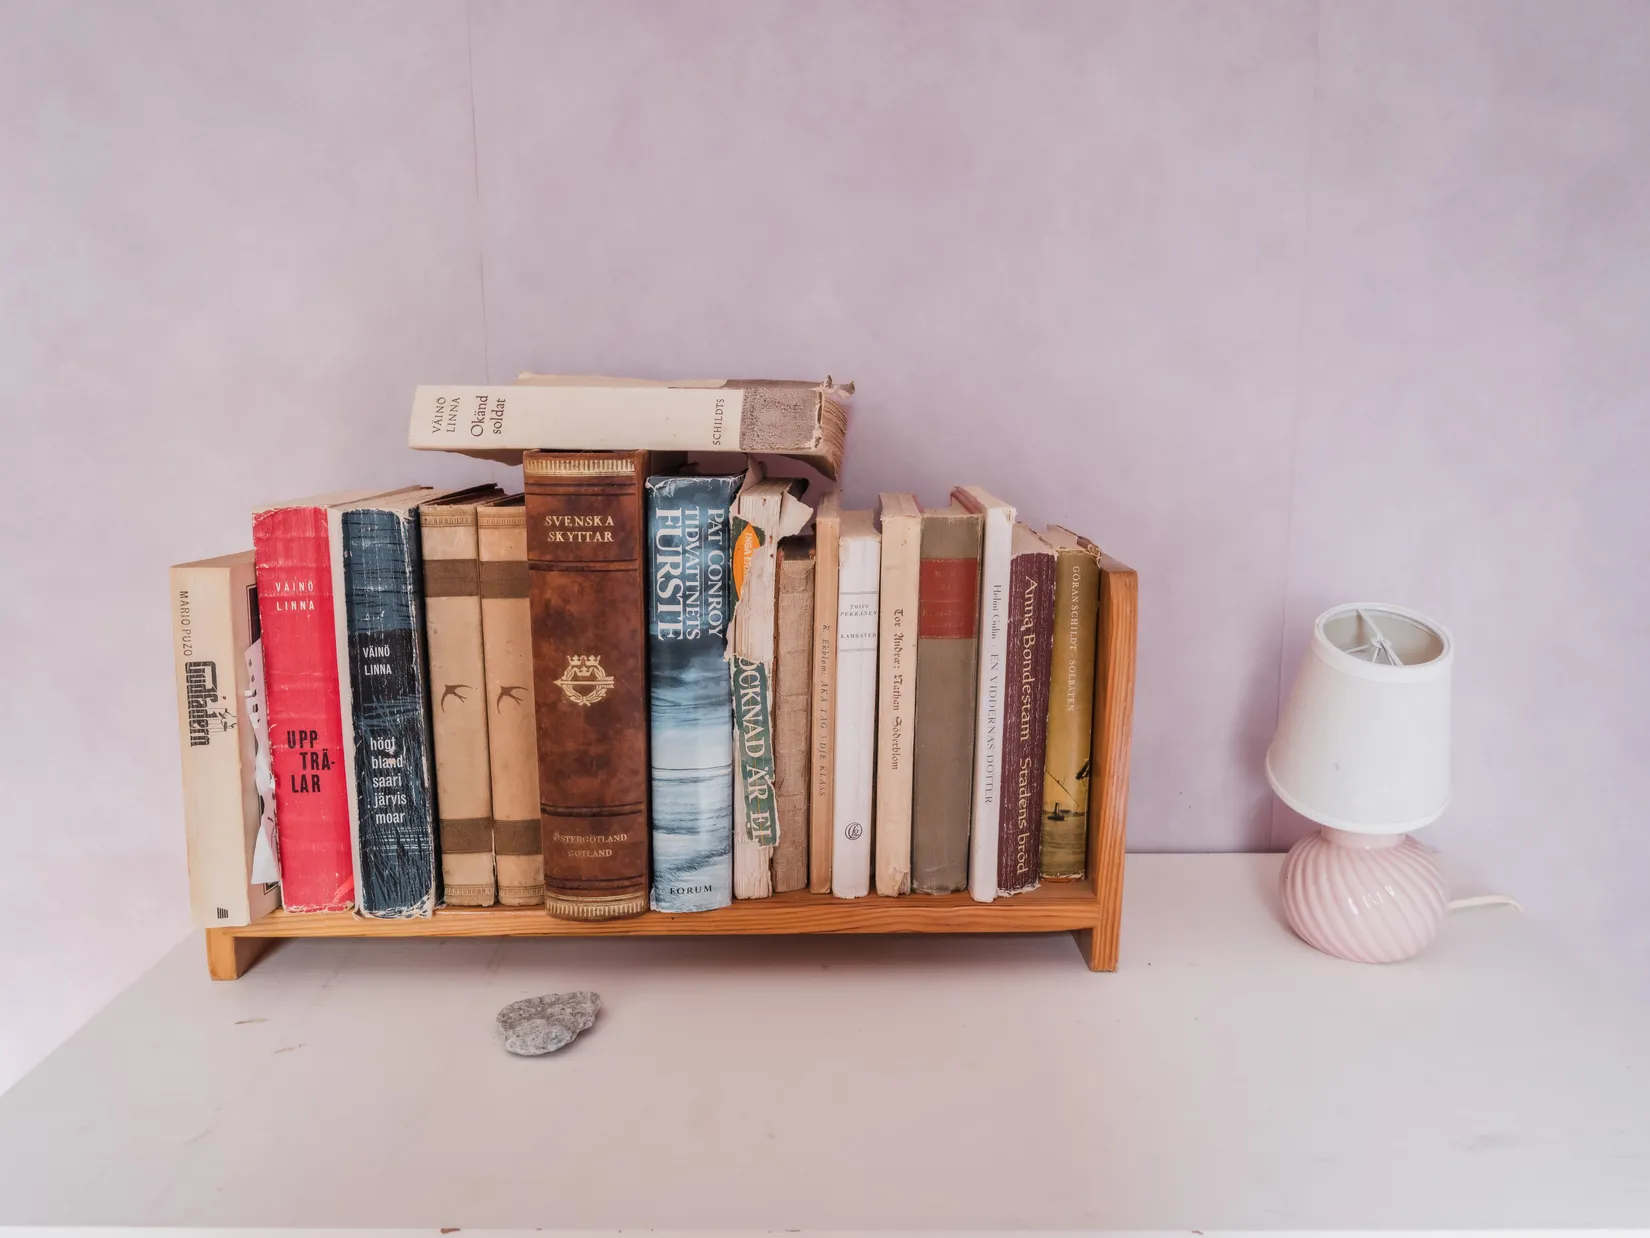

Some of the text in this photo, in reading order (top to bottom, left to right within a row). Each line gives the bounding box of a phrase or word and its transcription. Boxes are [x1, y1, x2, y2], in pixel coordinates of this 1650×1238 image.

[432, 396, 460, 433] VÄINÖ LINNA
[470, 395, 488, 437] Okänd
[490, 398, 506, 434] soldat
[712, 398, 725, 446] SCHILDTS
[544, 515, 615, 527] SVENSKA
[547, 531, 615, 542] SKYTTAR
[275, 580, 314, 592] VÄINÖ
[656, 507, 684, 641] FURSTE
[685, 506, 701, 640] TIDVATTNETS
[708, 508, 725, 638] PAT CONROY
[1071, 565, 1081, 602] GÖRAN
[276, 600, 315, 611] LINNA
[893, 608, 904, 628] Tor
[179, 590, 193, 657] MARIO PUZO
[822, 624, 830, 633] R.
[1069, 605, 1079, 651] SCHILDT
[362, 644, 391, 658] VÄINÖ
[364, 664, 392, 676] LINNA
[184, 661, 218, 747] Gudfadern
[893, 674, 903, 711] Nathan
[984, 585, 1002, 804] Helmi Gulin EN VIDDERNAS DOTTER
[1017, 576, 1038, 875] Anna Bondestam Stadens bröd
[287, 730, 318, 749] UPP
[370, 736, 396, 753] högt
[892, 716, 903, 770] Söderblom
[299, 748, 336, 770] TRÄ-
[371, 754, 404, 769] bland
[291, 774, 321, 793] LAR
[373, 773, 402, 788] saari
[746, 764, 769, 803] ÄR
[819, 765, 827, 796] KLASS
[373, 791, 407, 809] järvis
[375, 811, 405, 824] moar
[670, 884, 712, 895] FORUM
